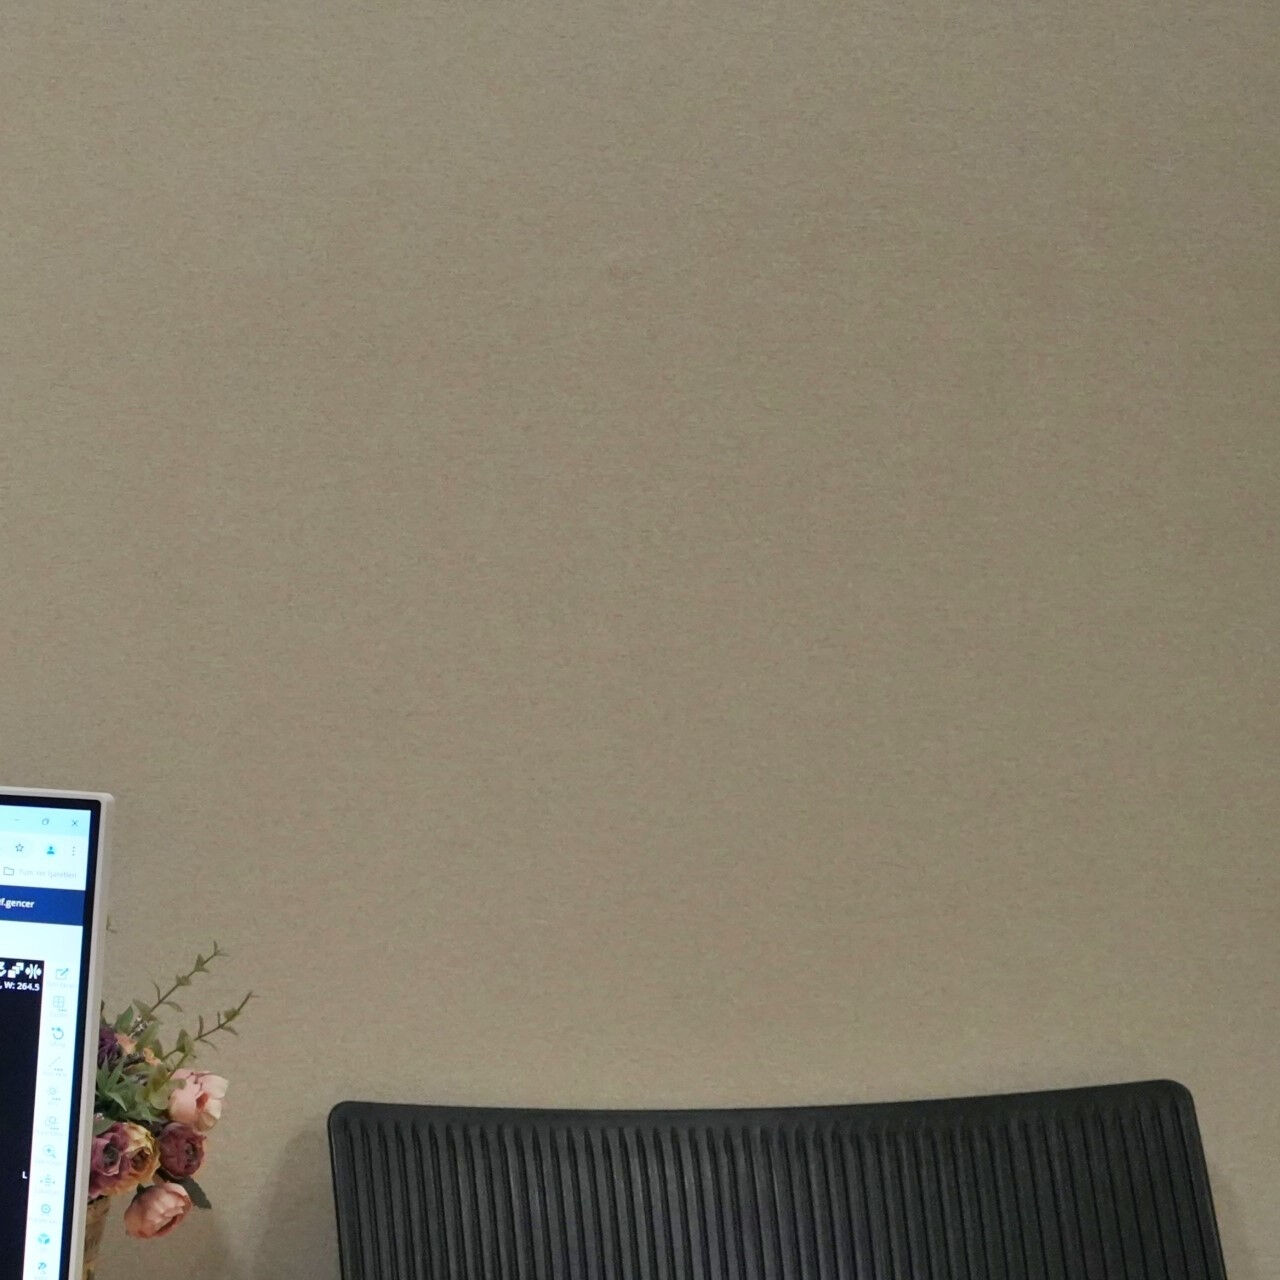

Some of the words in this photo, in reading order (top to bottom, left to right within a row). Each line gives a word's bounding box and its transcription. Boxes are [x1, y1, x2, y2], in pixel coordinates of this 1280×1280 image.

[4, 981, 15, 990] W:
[16, 982, 40, 991] 264.5
[22, 1171, 28, 1179] L
